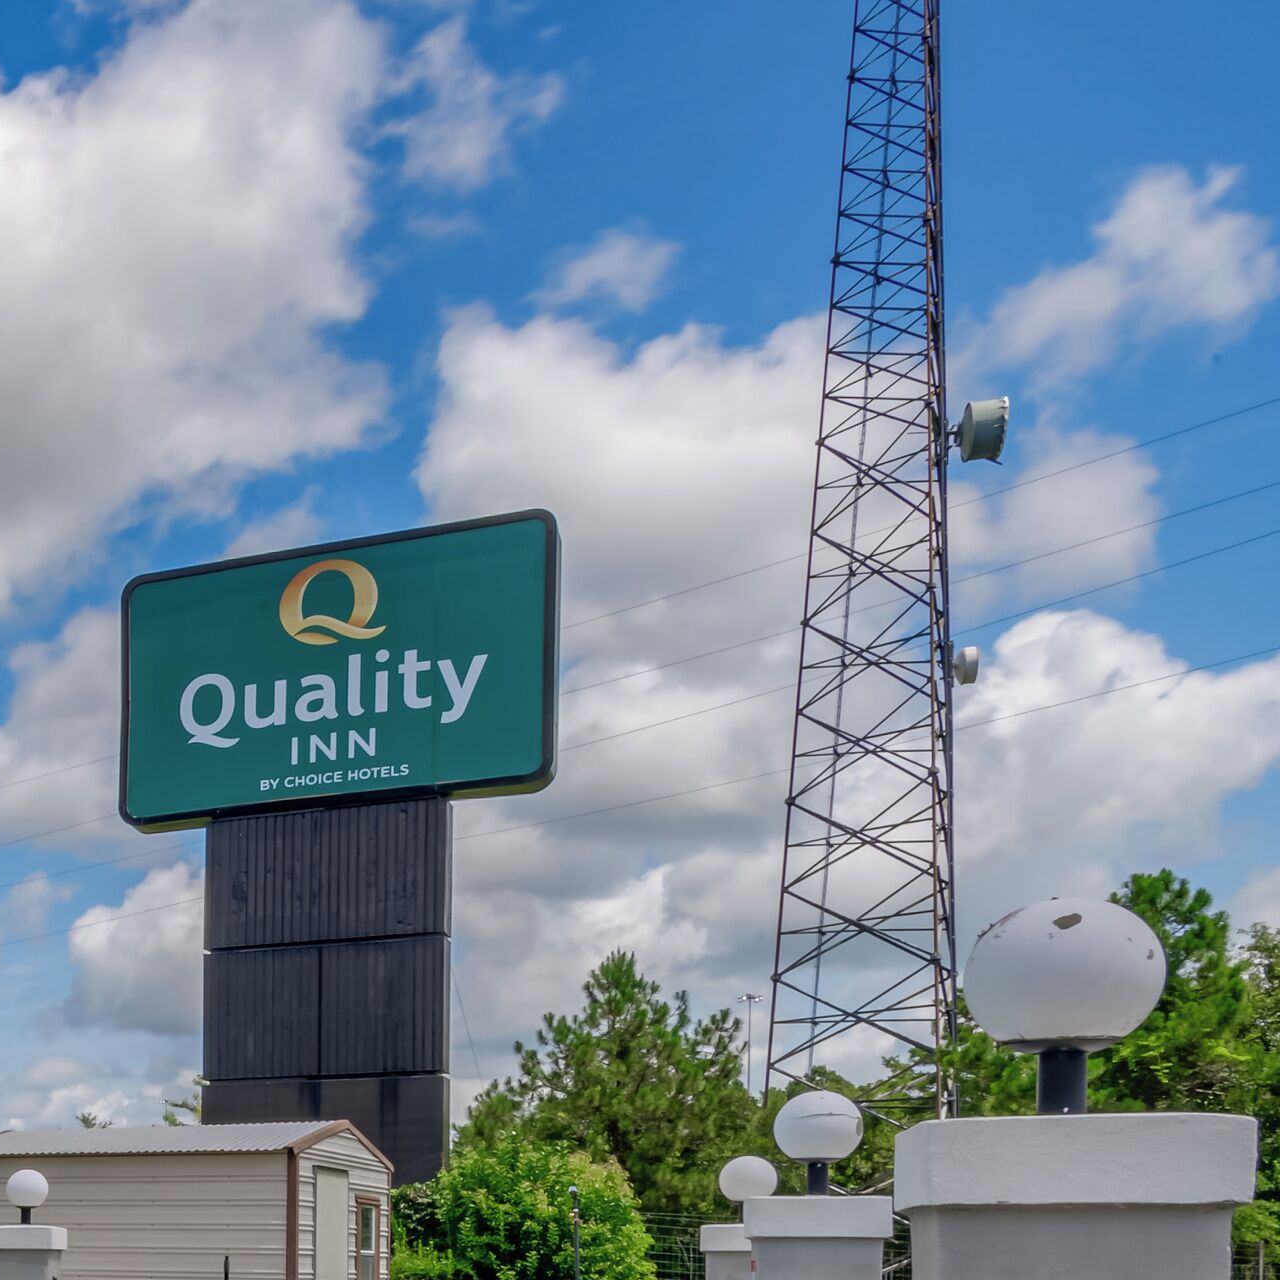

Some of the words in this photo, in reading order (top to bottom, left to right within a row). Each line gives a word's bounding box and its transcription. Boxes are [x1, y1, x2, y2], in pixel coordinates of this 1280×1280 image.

[179, 649, 488, 748] Quality
[290, 727, 377, 765] INN
[260, 778, 280, 791] BY
[284, 771, 344, 788] CHOICE
[348, 764, 410, 781] HOTELS
